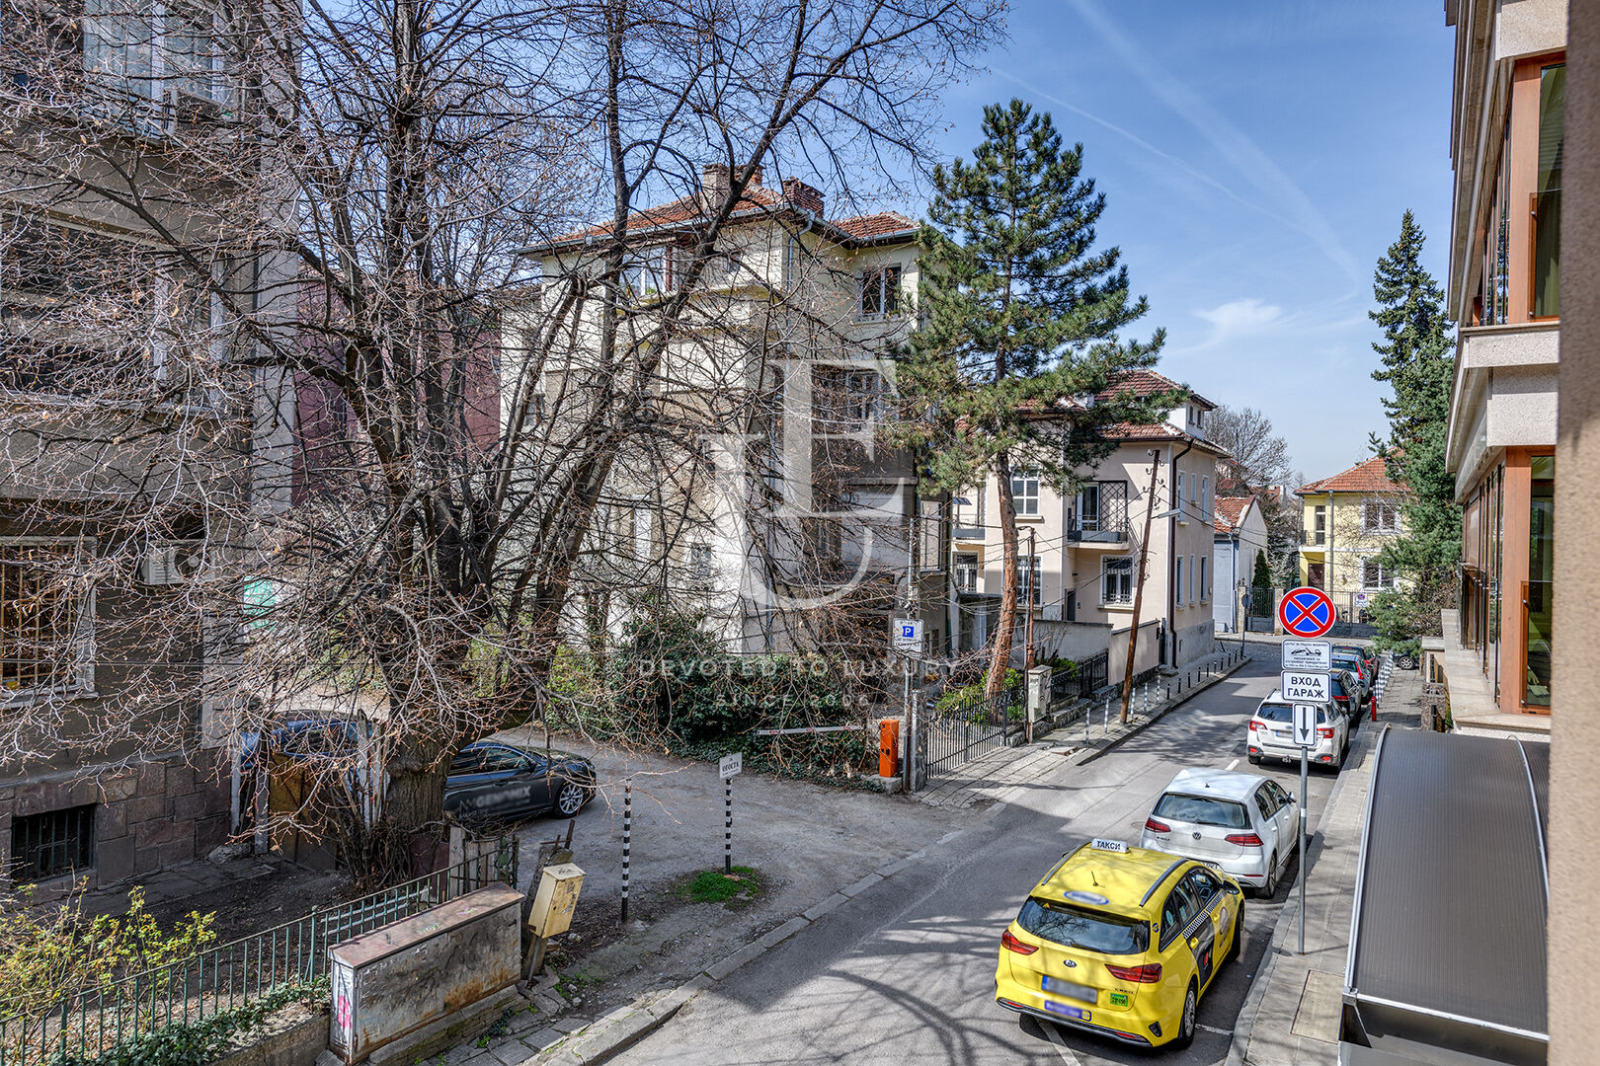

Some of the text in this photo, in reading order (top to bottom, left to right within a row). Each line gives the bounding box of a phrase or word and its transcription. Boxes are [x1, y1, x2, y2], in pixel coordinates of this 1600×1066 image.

[1291, 676, 1321, 687] ВХОД
[1287, 687, 1325, 698] ГАРАЖ
[1096, 840, 1121, 850] ТАКСИ
